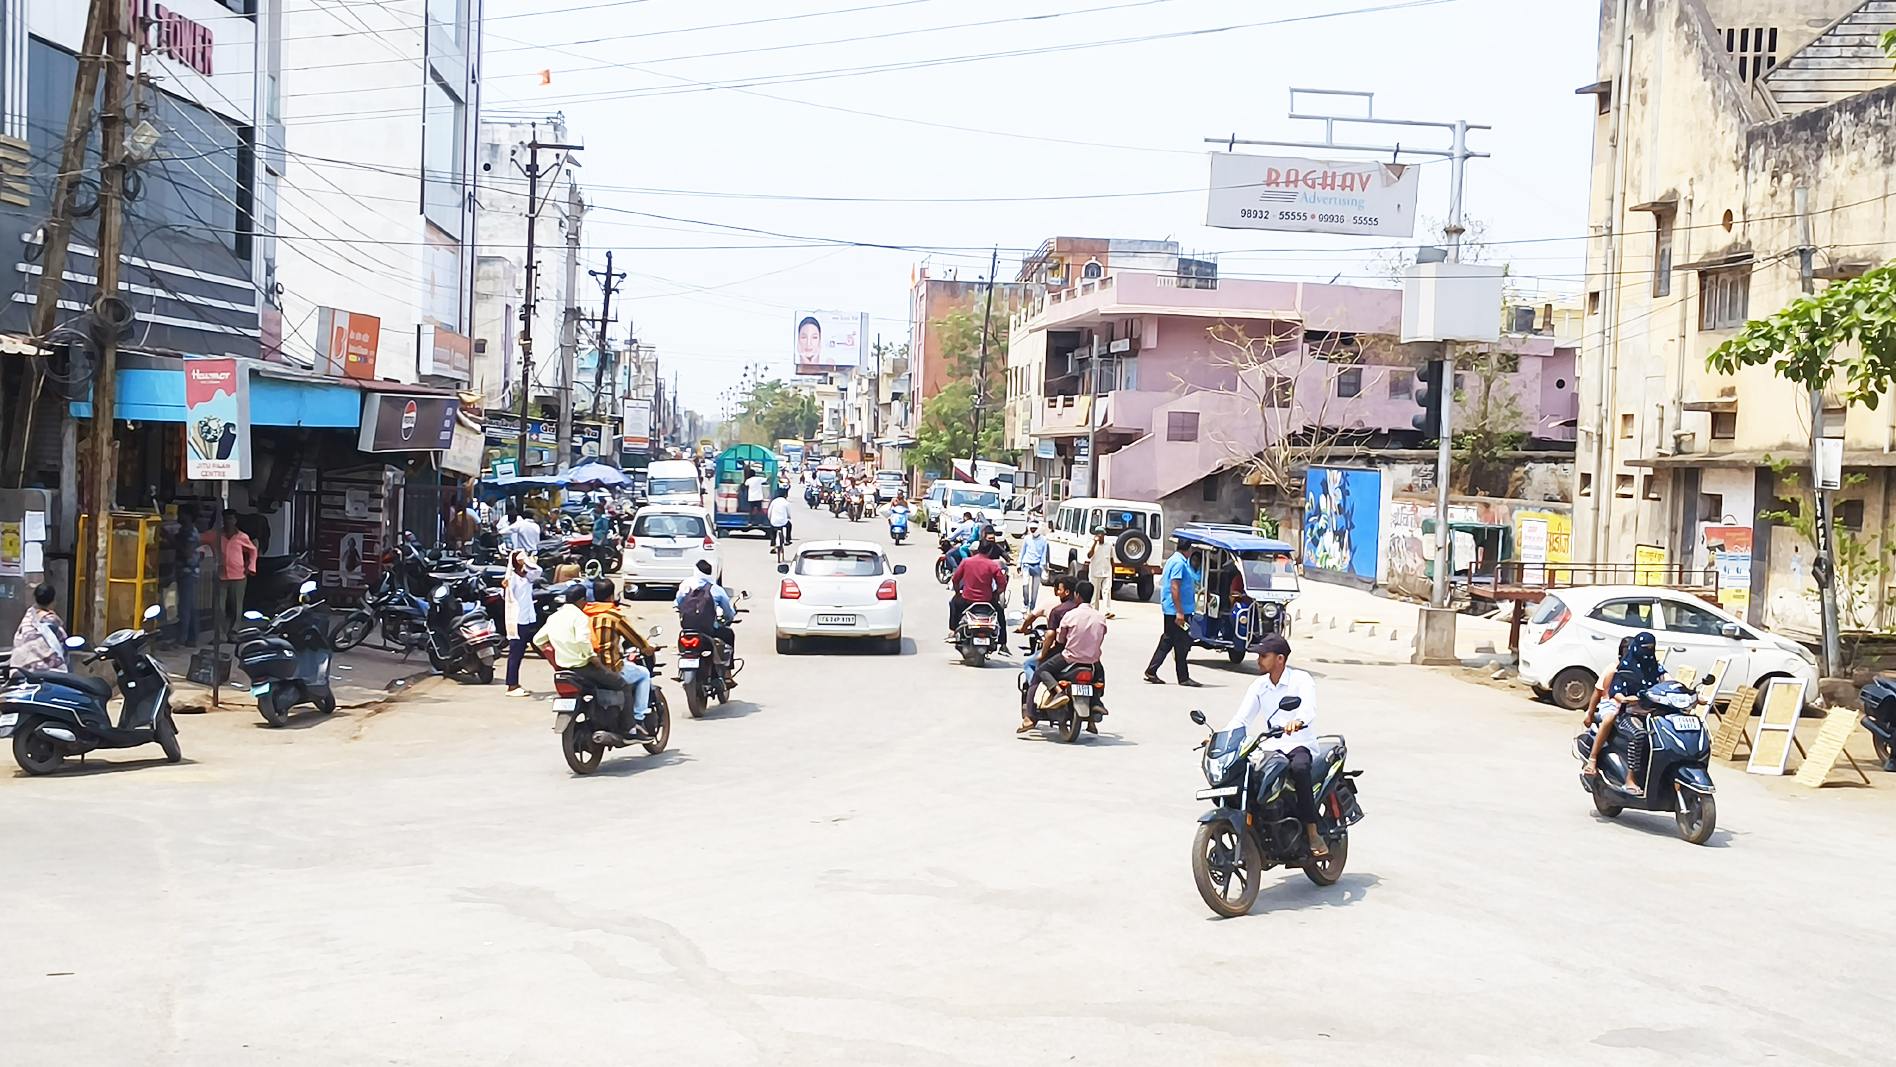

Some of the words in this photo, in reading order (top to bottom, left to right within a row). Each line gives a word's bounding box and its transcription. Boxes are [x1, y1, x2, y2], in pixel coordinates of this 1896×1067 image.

[155, 3, 213, 77] TOWER
[1262, 167, 1371, 192] RAGHAV
[1300, 191, 1365, 211] Advertising
[1240, 208, 1270, 219] 98932
[1279, 210, 1308, 221] 55555
[1352, 215, 1379, 226] 55555
